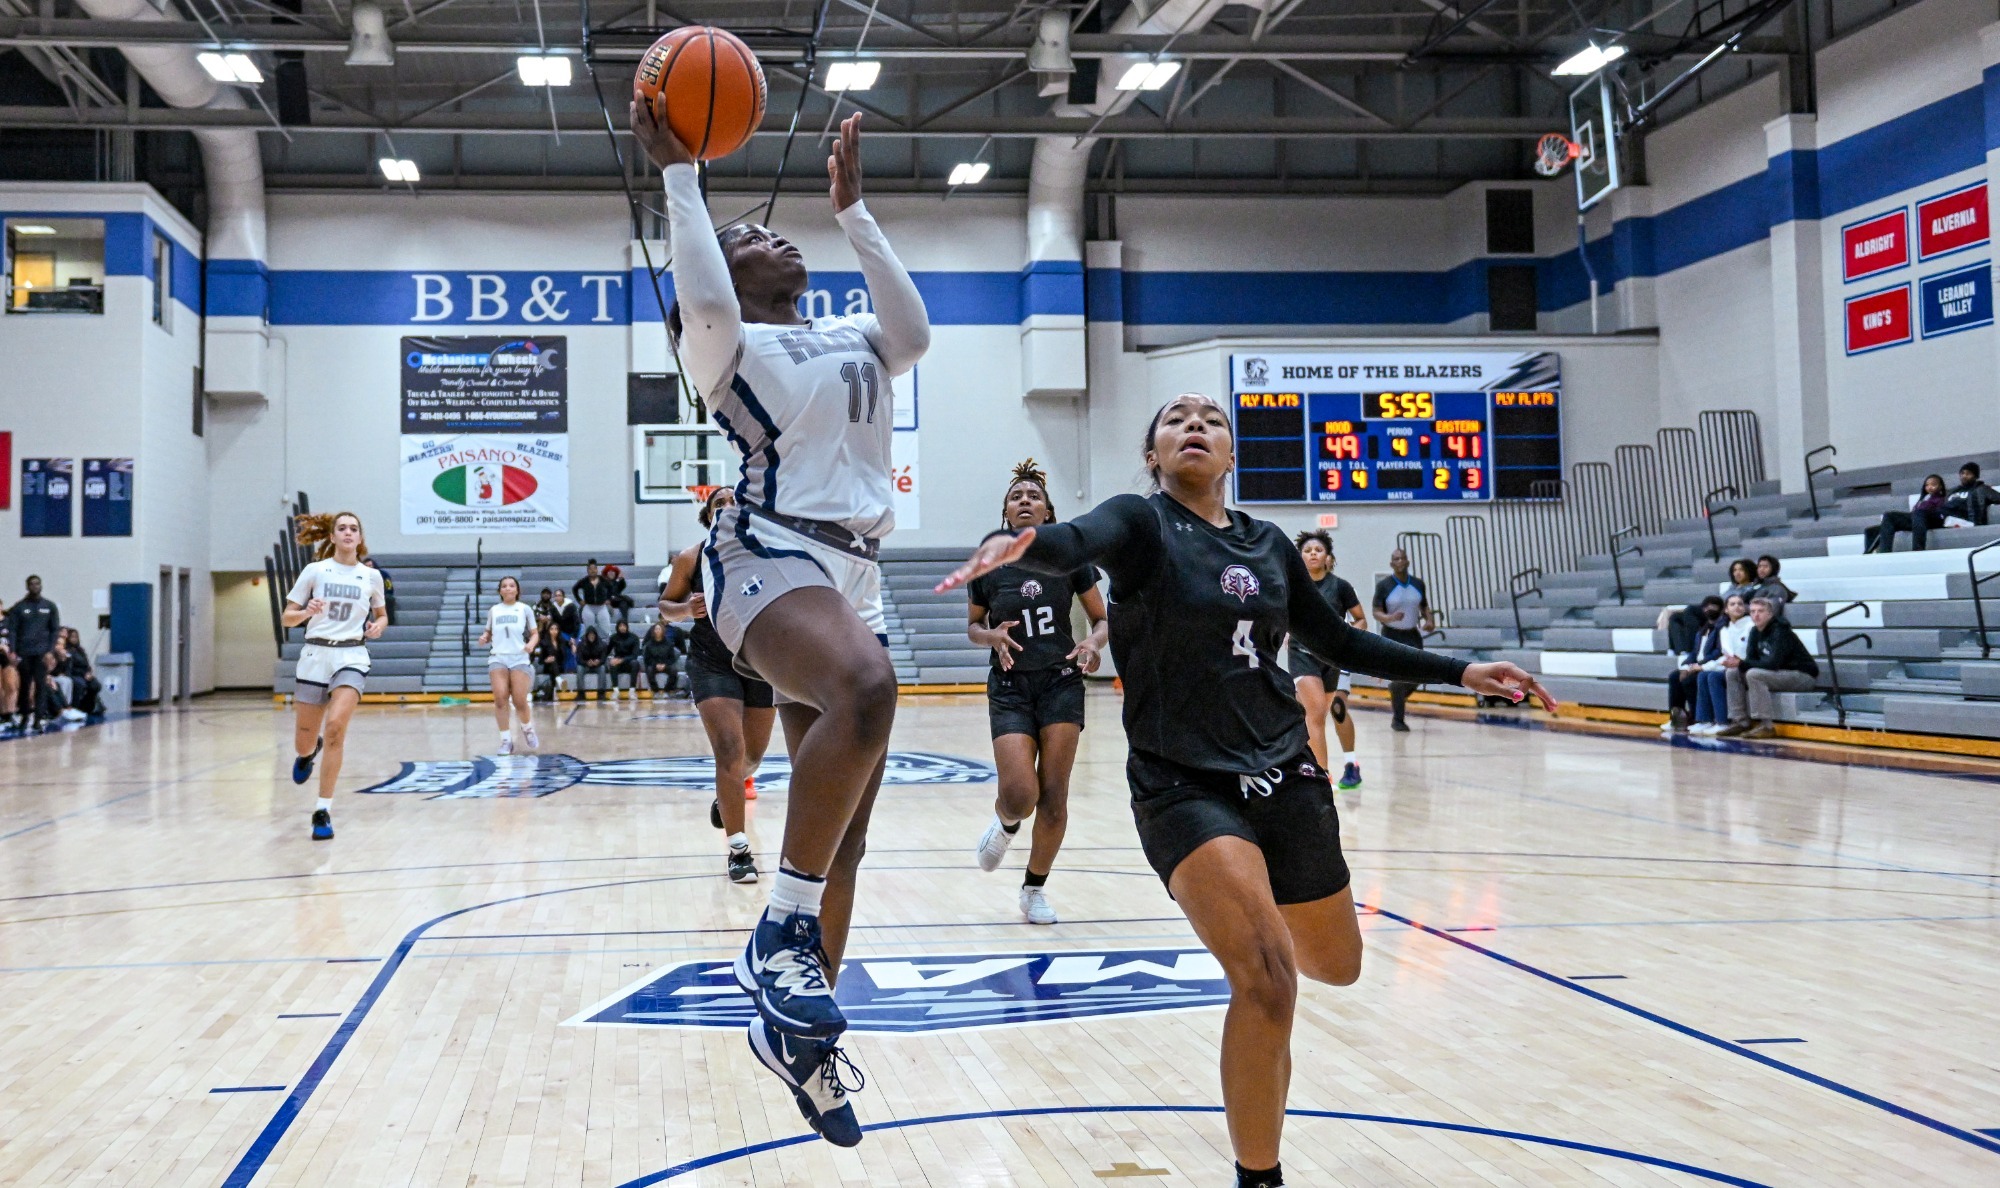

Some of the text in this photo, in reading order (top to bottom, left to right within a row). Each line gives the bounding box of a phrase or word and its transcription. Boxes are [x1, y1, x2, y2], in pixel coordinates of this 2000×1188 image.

[1931, 207, 1977, 236] ALVERNIA
[1854, 232, 1895, 259] ALBRIGHT
[1938, 281, 1975, 304] LEBANON
[1942, 298, 1972, 318] VALLEY
[1862, 309, 1892, 331] KING'S
[443, 365, 480, 374] mechanics
[1282, 365, 1482, 379] HOME OF THE BLAZERS
[840, 362, 878, 424] 11
[1240, 393, 1299, 407] PLY FL PTS
[1379, 393, 1433, 418] 5:55
[1325, 421, 1352, 434] HOOD
[1387, 427, 1412, 436] PERIOD
[1435, 420, 1480, 433] EASTERN
[422, 440, 435, 449] GO
[517, 443, 563, 462] BLAZERS!
[535, 439, 549, 448] GO
[1326, 435, 1360, 459] 49
[1392, 438, 1409, 457] 4
[1447, 435, 1482, 458] 41
[408, 444, 455, 463] BLAZERS!
[437, 448, 533, 469] PAISANO'S
[1318, 461, 1342, 469] FOULS
[1458, 461, 1481, 469] FOULS
[1327, 470, 1342, 490] 3
[1352, 470, 1368, 489] 4
[1434, 468, 1450, 490] 2
[1467, 468, 1482, 489] 3
[1319, 492, 1336, 500] WON
[1387, 491, 1413, 499] MATCH
[1462, 491, 1479, 499] WON
[416, 516, 435, 525] (301)
[483, 516, 553, 524] paisanospizza.com
[324, 583, 361, 600] HOOD
[328, 601, 353, 622] 50
[1021, 606, 1054, 637] 12
[505, 626, 510, 638] 1
[1232, 620, 1259, 669] 4
